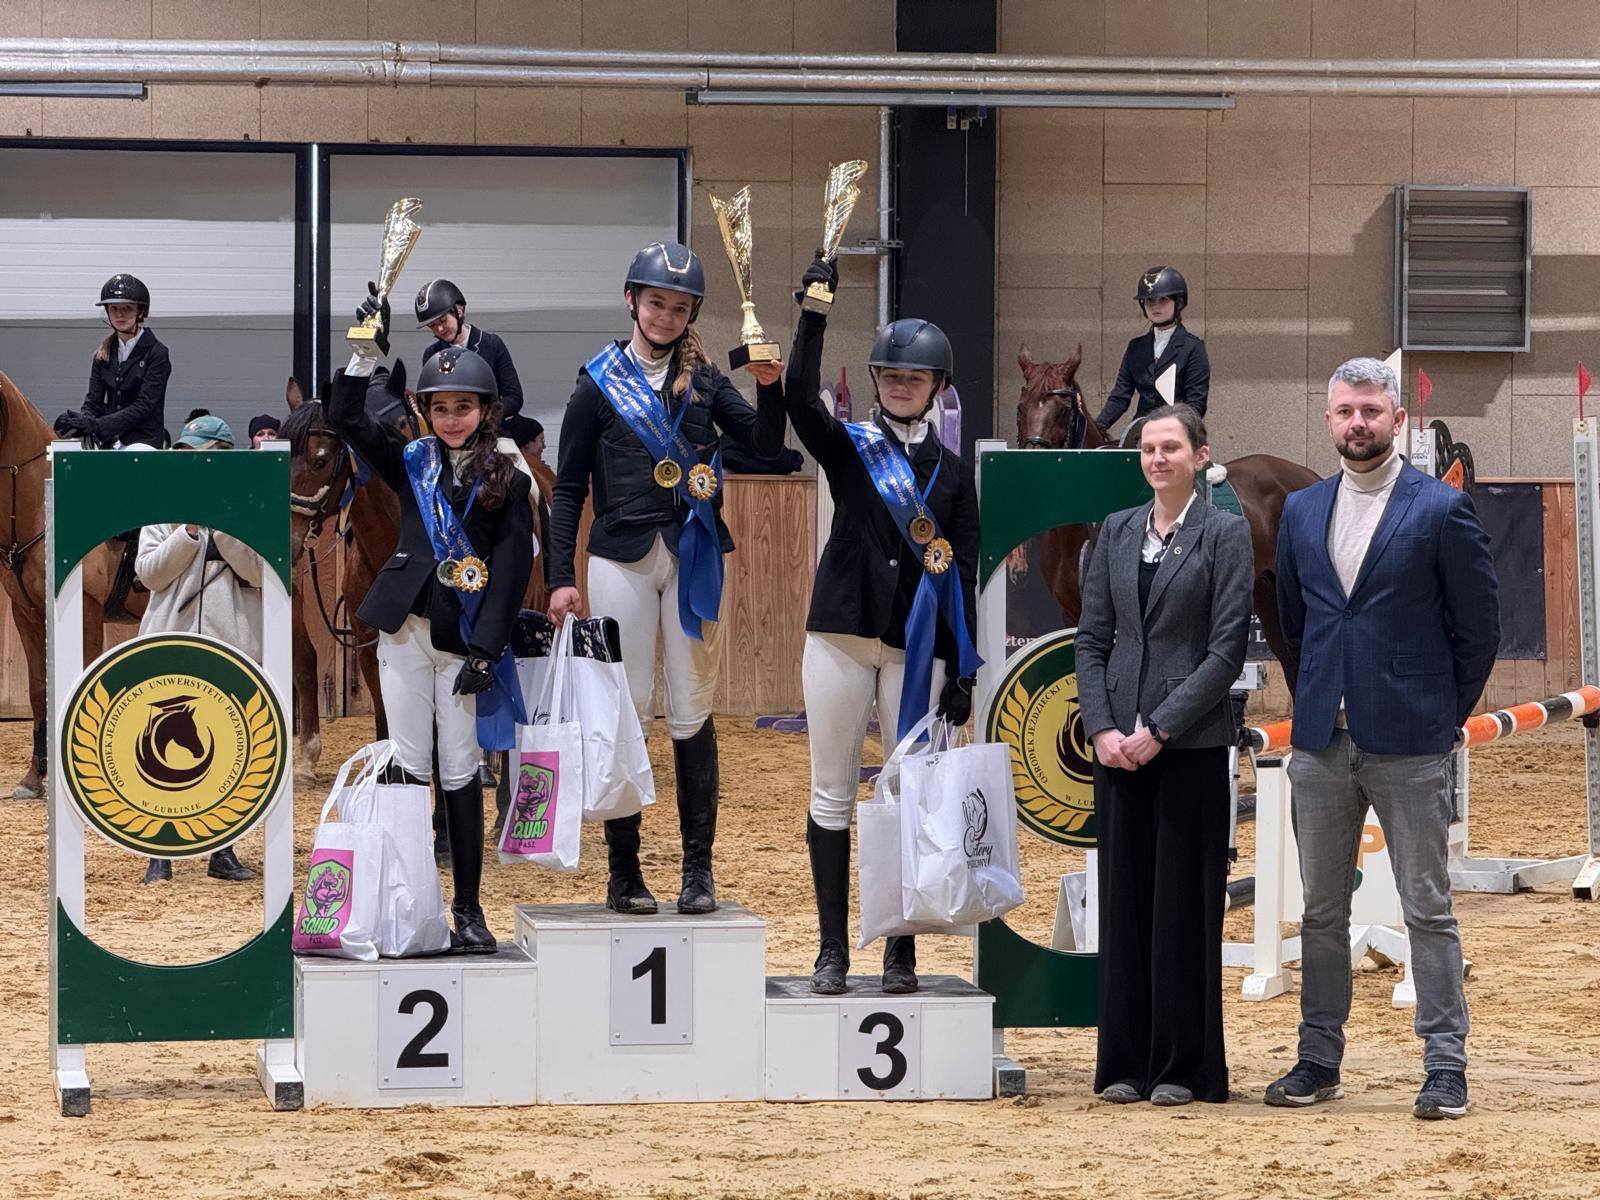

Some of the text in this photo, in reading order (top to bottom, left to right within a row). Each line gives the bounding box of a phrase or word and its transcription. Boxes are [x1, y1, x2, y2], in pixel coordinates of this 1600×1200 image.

[149, 677, 225, 704] UNIWERSYTETU
[154, 801, 202, 814] LUBLINIE
[300, 916, 341, 936] SQUAD
[632, 947, 667, 1025] 1
[396, 989, 449, 1069] 2
[856, 1012, 908, 1091] 3
